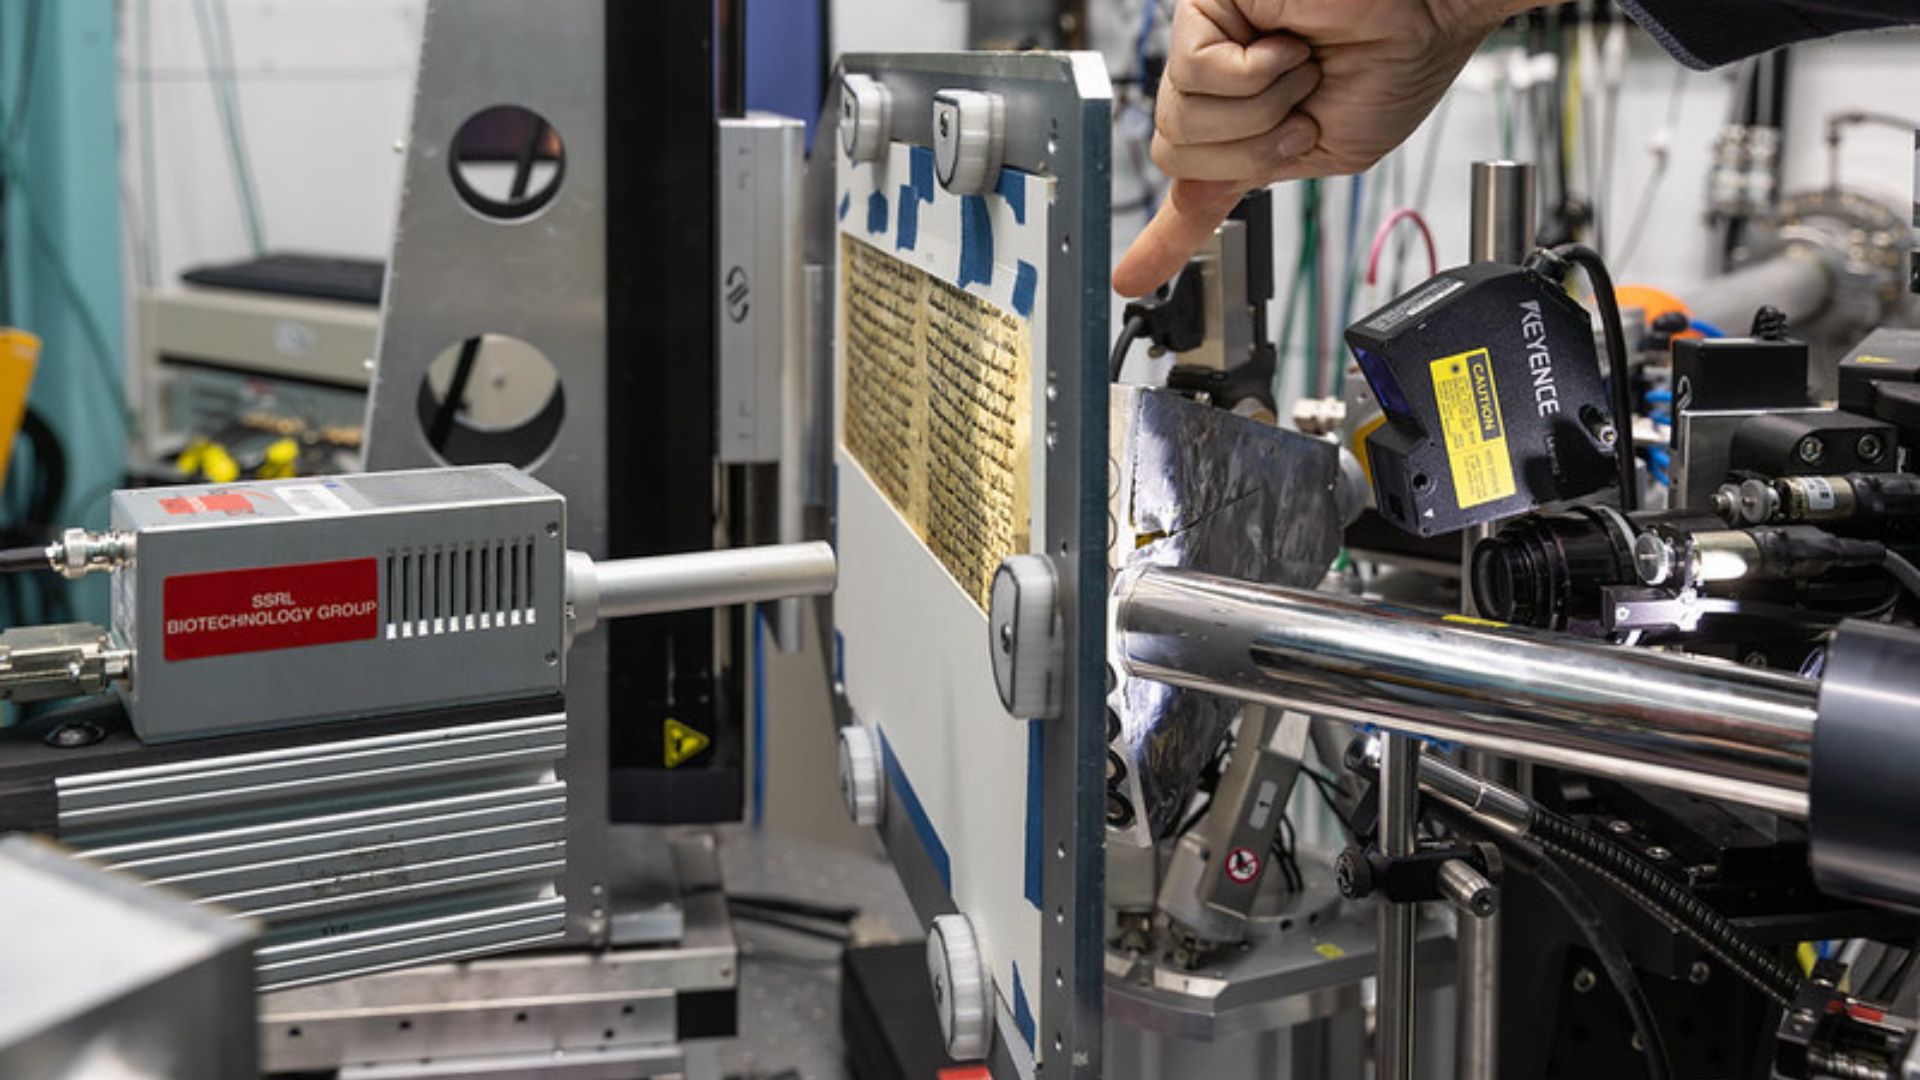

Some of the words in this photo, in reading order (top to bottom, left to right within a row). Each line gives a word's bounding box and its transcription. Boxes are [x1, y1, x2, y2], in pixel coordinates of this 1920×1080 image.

[1519, 299, 1560, 418] KEYENCE
[1472, 363, 1496, 431] CAUTION
[167, 607, 314, 635] BIOTECHNOLOGY
[317, 601, 377, 620] GROUP
[252, 591, 296, 609] SSRL
